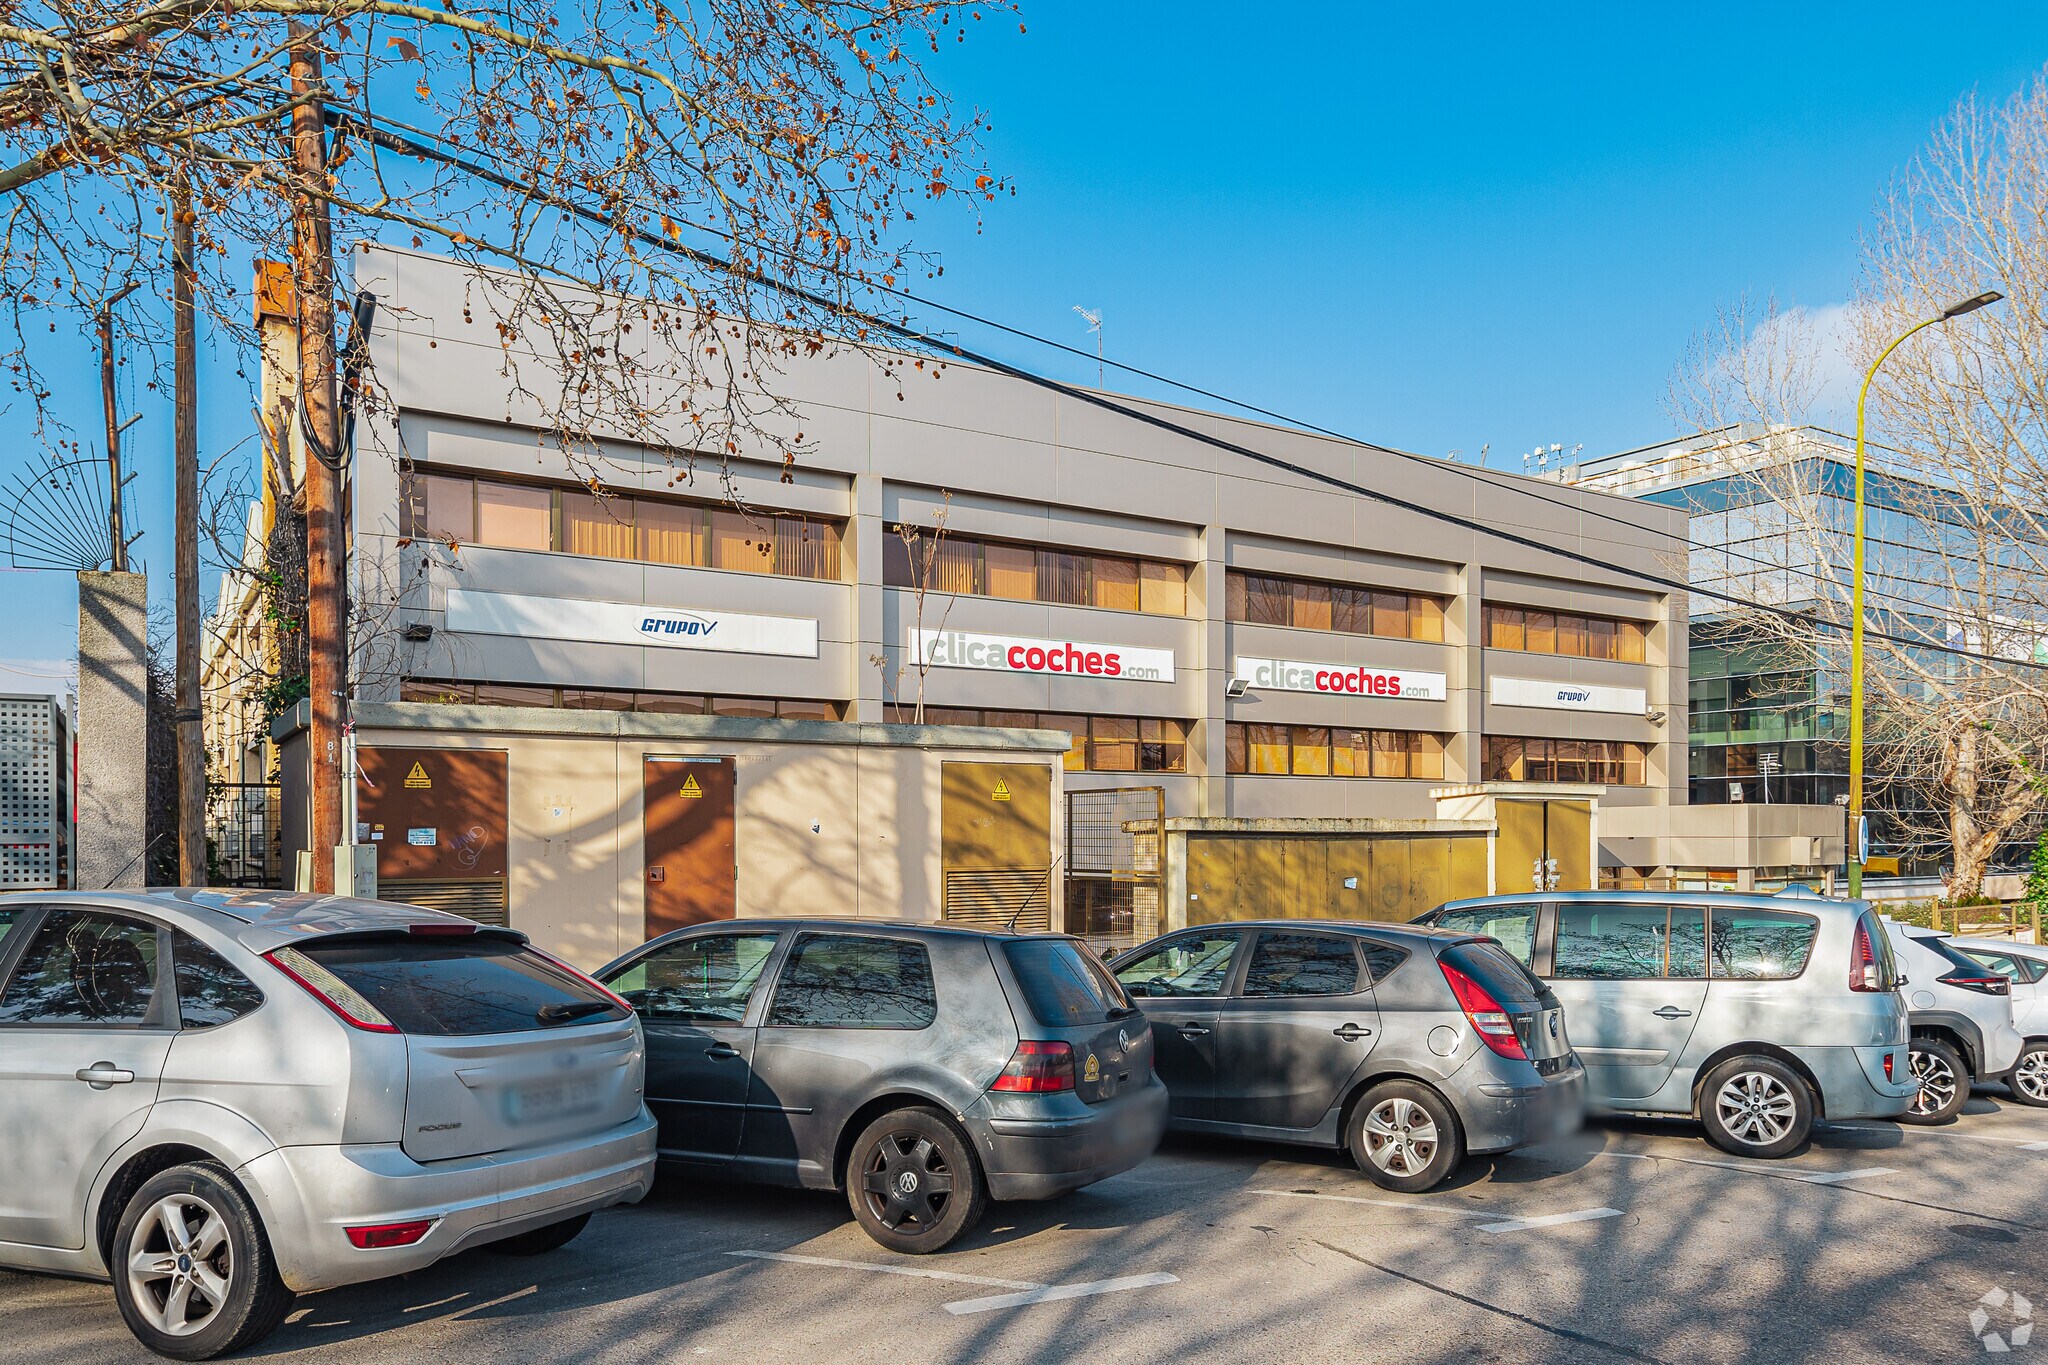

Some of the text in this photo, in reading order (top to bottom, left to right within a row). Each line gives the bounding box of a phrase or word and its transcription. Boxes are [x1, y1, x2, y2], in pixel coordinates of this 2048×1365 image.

[926, 631, 1160, 680] clicacoches.com
[1255, 660, 1430, 698] clicacoches.com
[418, 1122, 462, 1133] FOCUS
